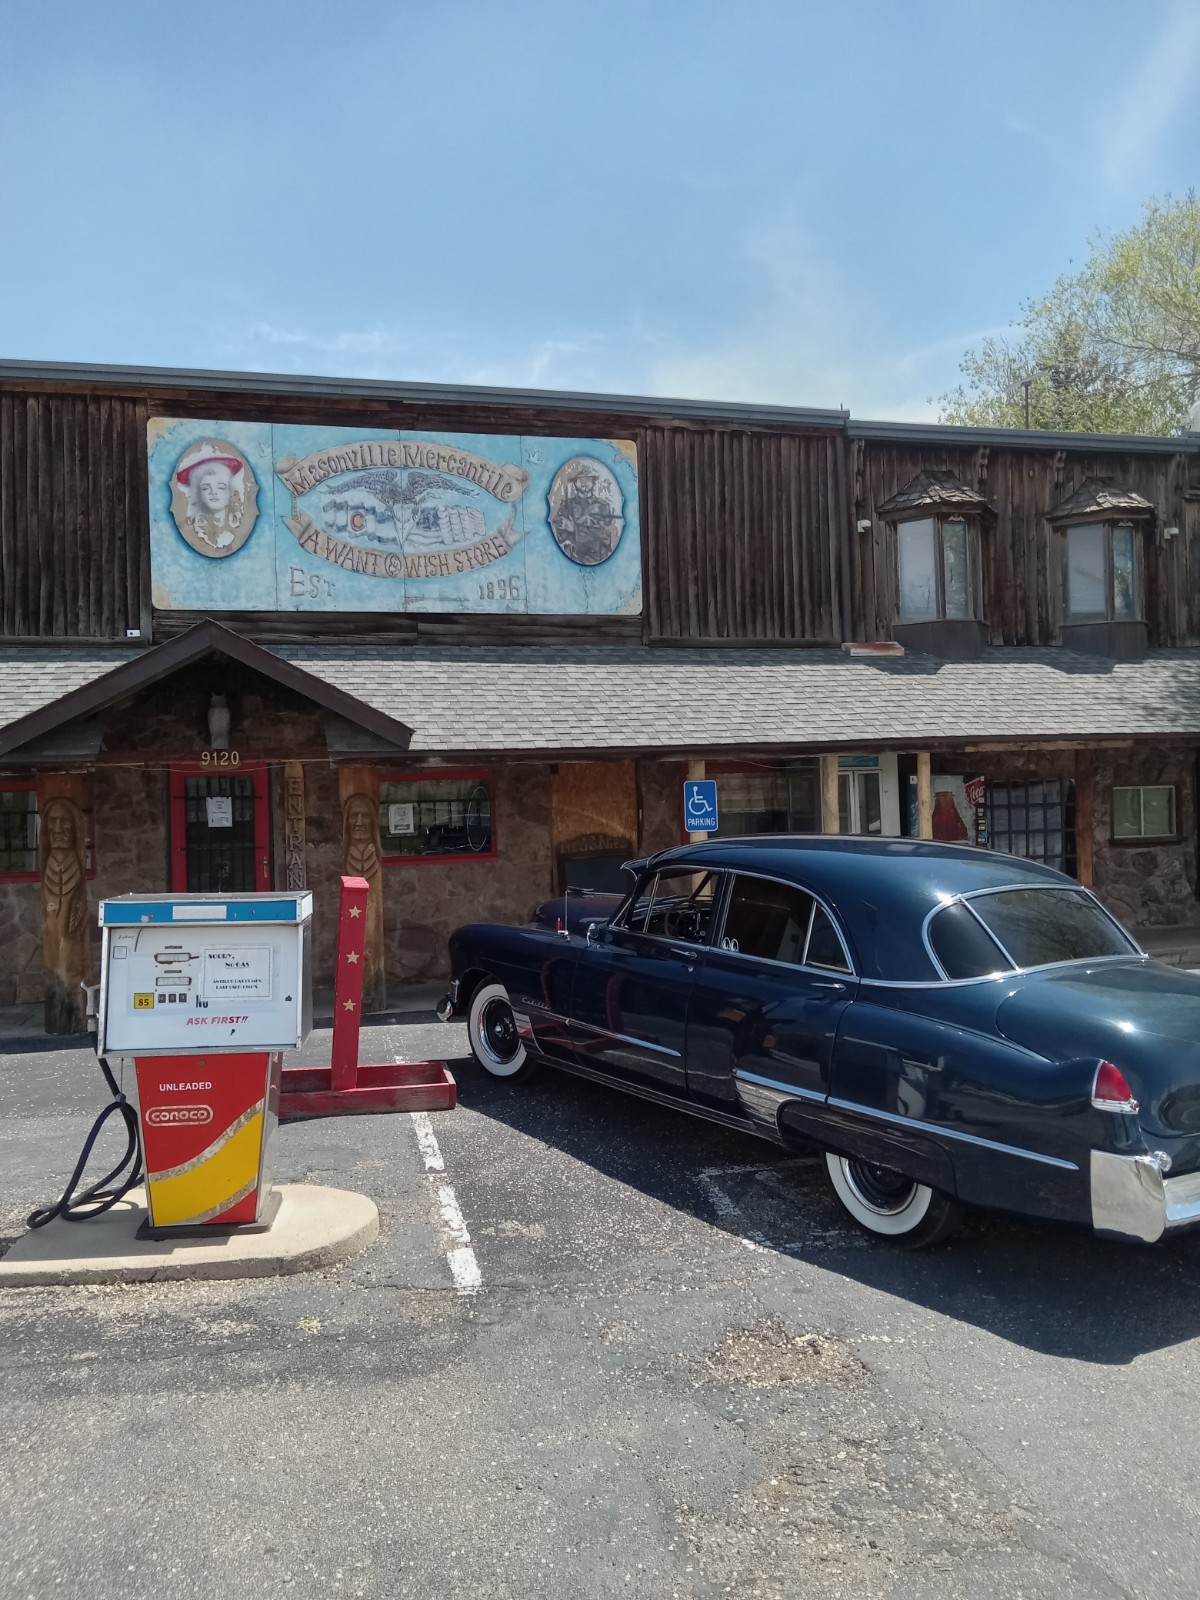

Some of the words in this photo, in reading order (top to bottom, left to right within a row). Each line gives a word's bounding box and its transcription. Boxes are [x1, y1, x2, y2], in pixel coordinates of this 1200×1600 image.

[284, 444, 397, 495] Masonville
[402, 444, 513, 500] Mercantile
[299, 528, 321, 554] A
[325, 536, 382, 574] WANT
[403, 552, 452, 578] WISH
[452, 536, 508, 573] STORE
[478, 575, 520, 600] 1896
[201, 751, 240, 766] 9120
[687, 817, 716, 826] PARKING
[138, 998, 150, 1007] 85
[186, 1017, 208, 1026] ASK
[211, 1015, 249, 1025] FIRST!!
[159, 1081, 212, 1092] UNLEADED
